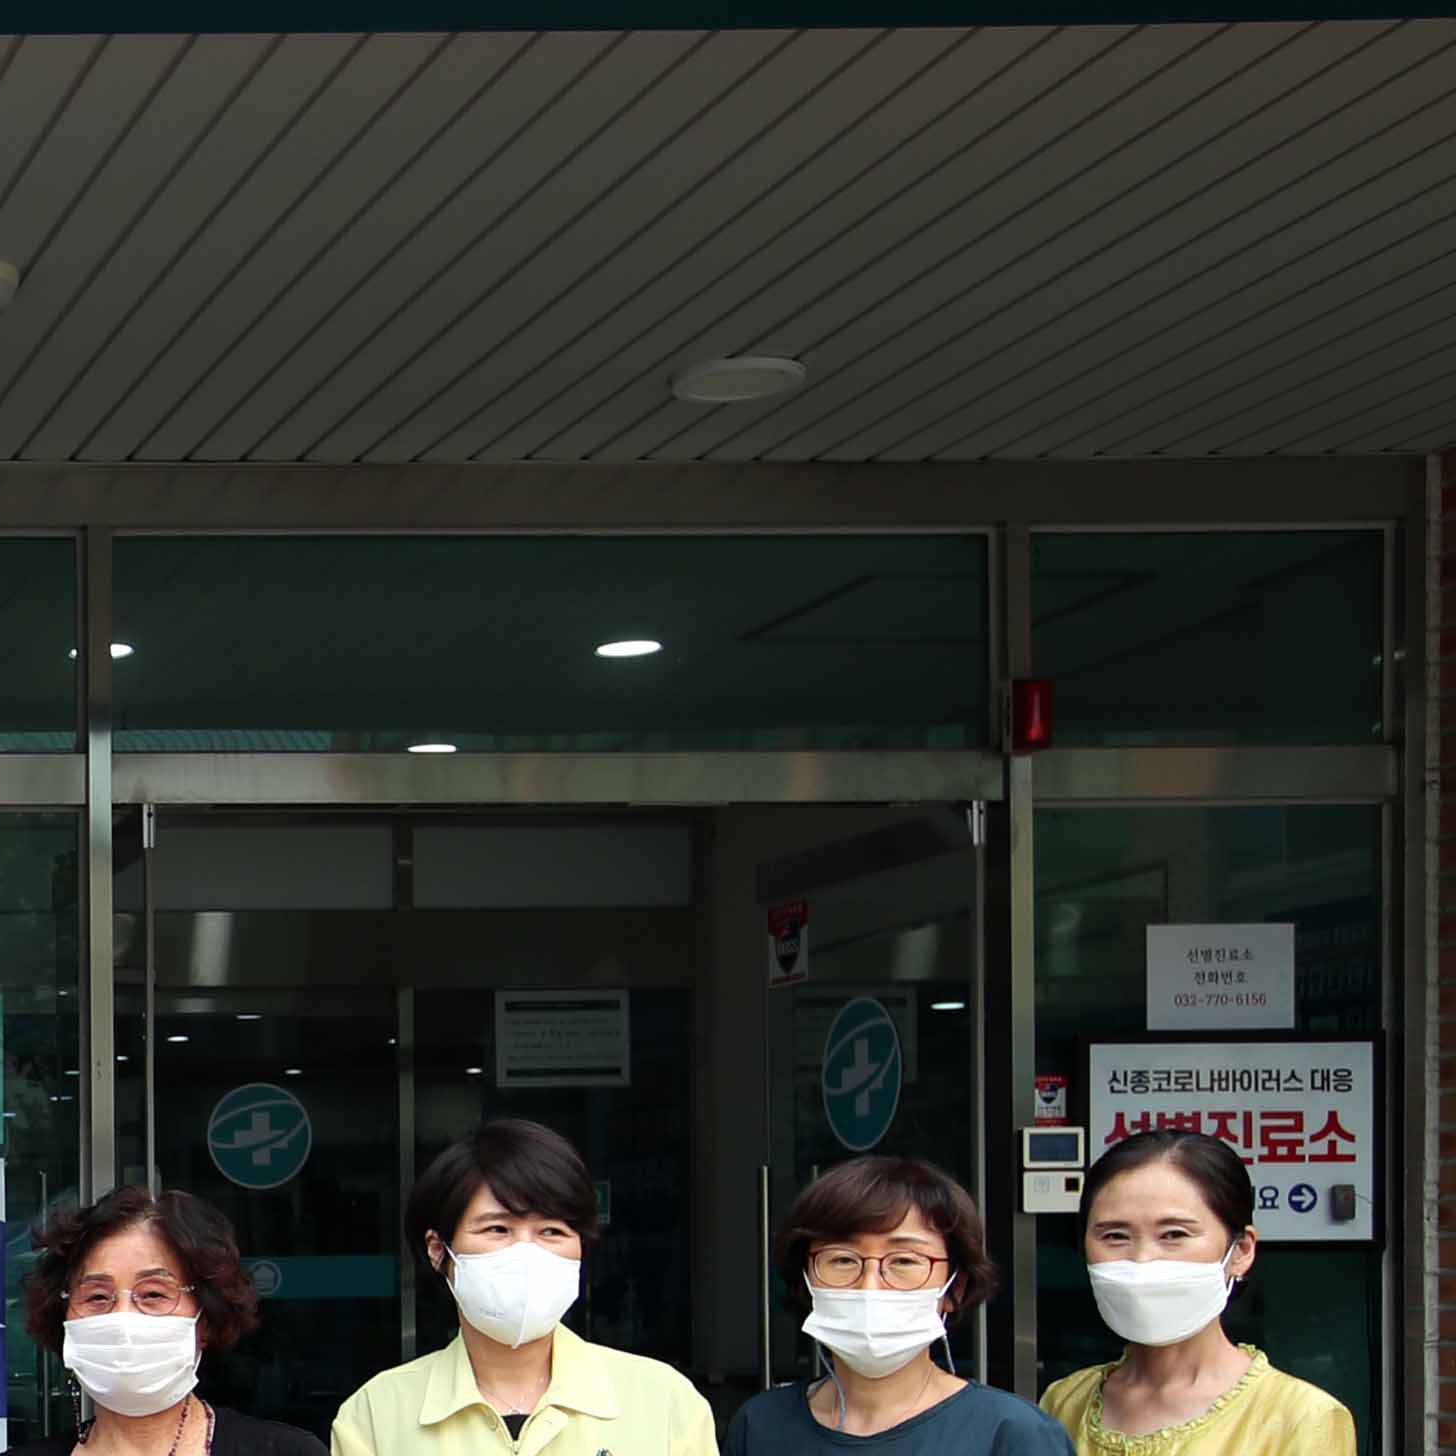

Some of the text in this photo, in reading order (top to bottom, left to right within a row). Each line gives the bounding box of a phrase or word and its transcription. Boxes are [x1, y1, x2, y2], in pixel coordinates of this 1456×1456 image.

[1187, 949, 1254, 962] 선별진료소
[1194, 972, 1248, 984] 전화번호
[1108, 1068, 1353, 1094] 신종코로나바이러스 대응
